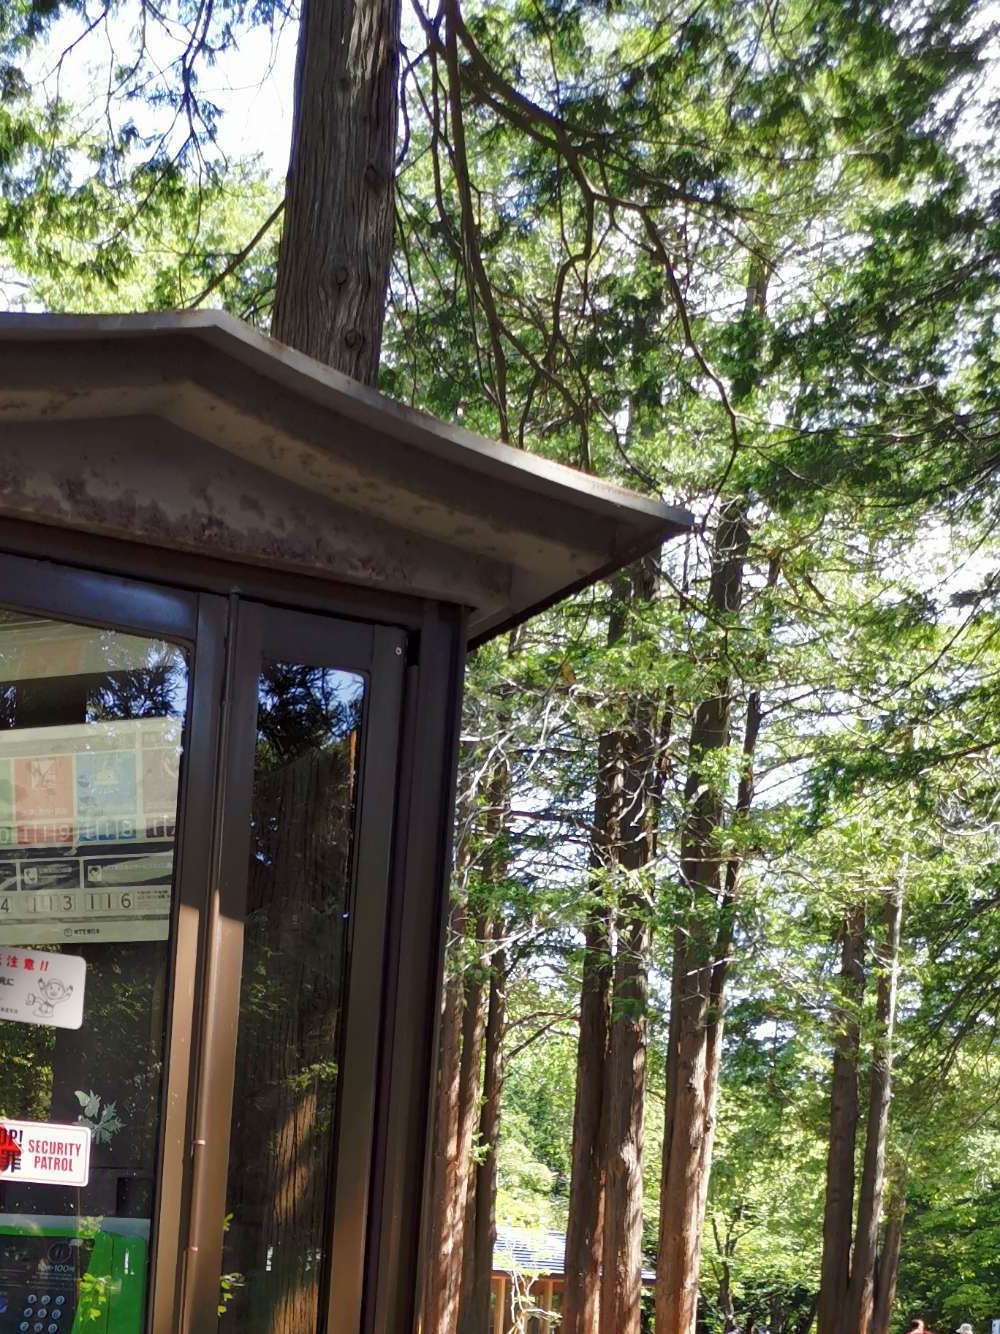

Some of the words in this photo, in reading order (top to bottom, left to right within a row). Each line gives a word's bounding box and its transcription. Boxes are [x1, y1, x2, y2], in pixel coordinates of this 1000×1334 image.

[33, 894, 73, 914] 113
[90, 892, 132, 910] 116
[28, 1139, 81, 1157] SECURITY
[34, 1156, 74, 1173] PATROL
